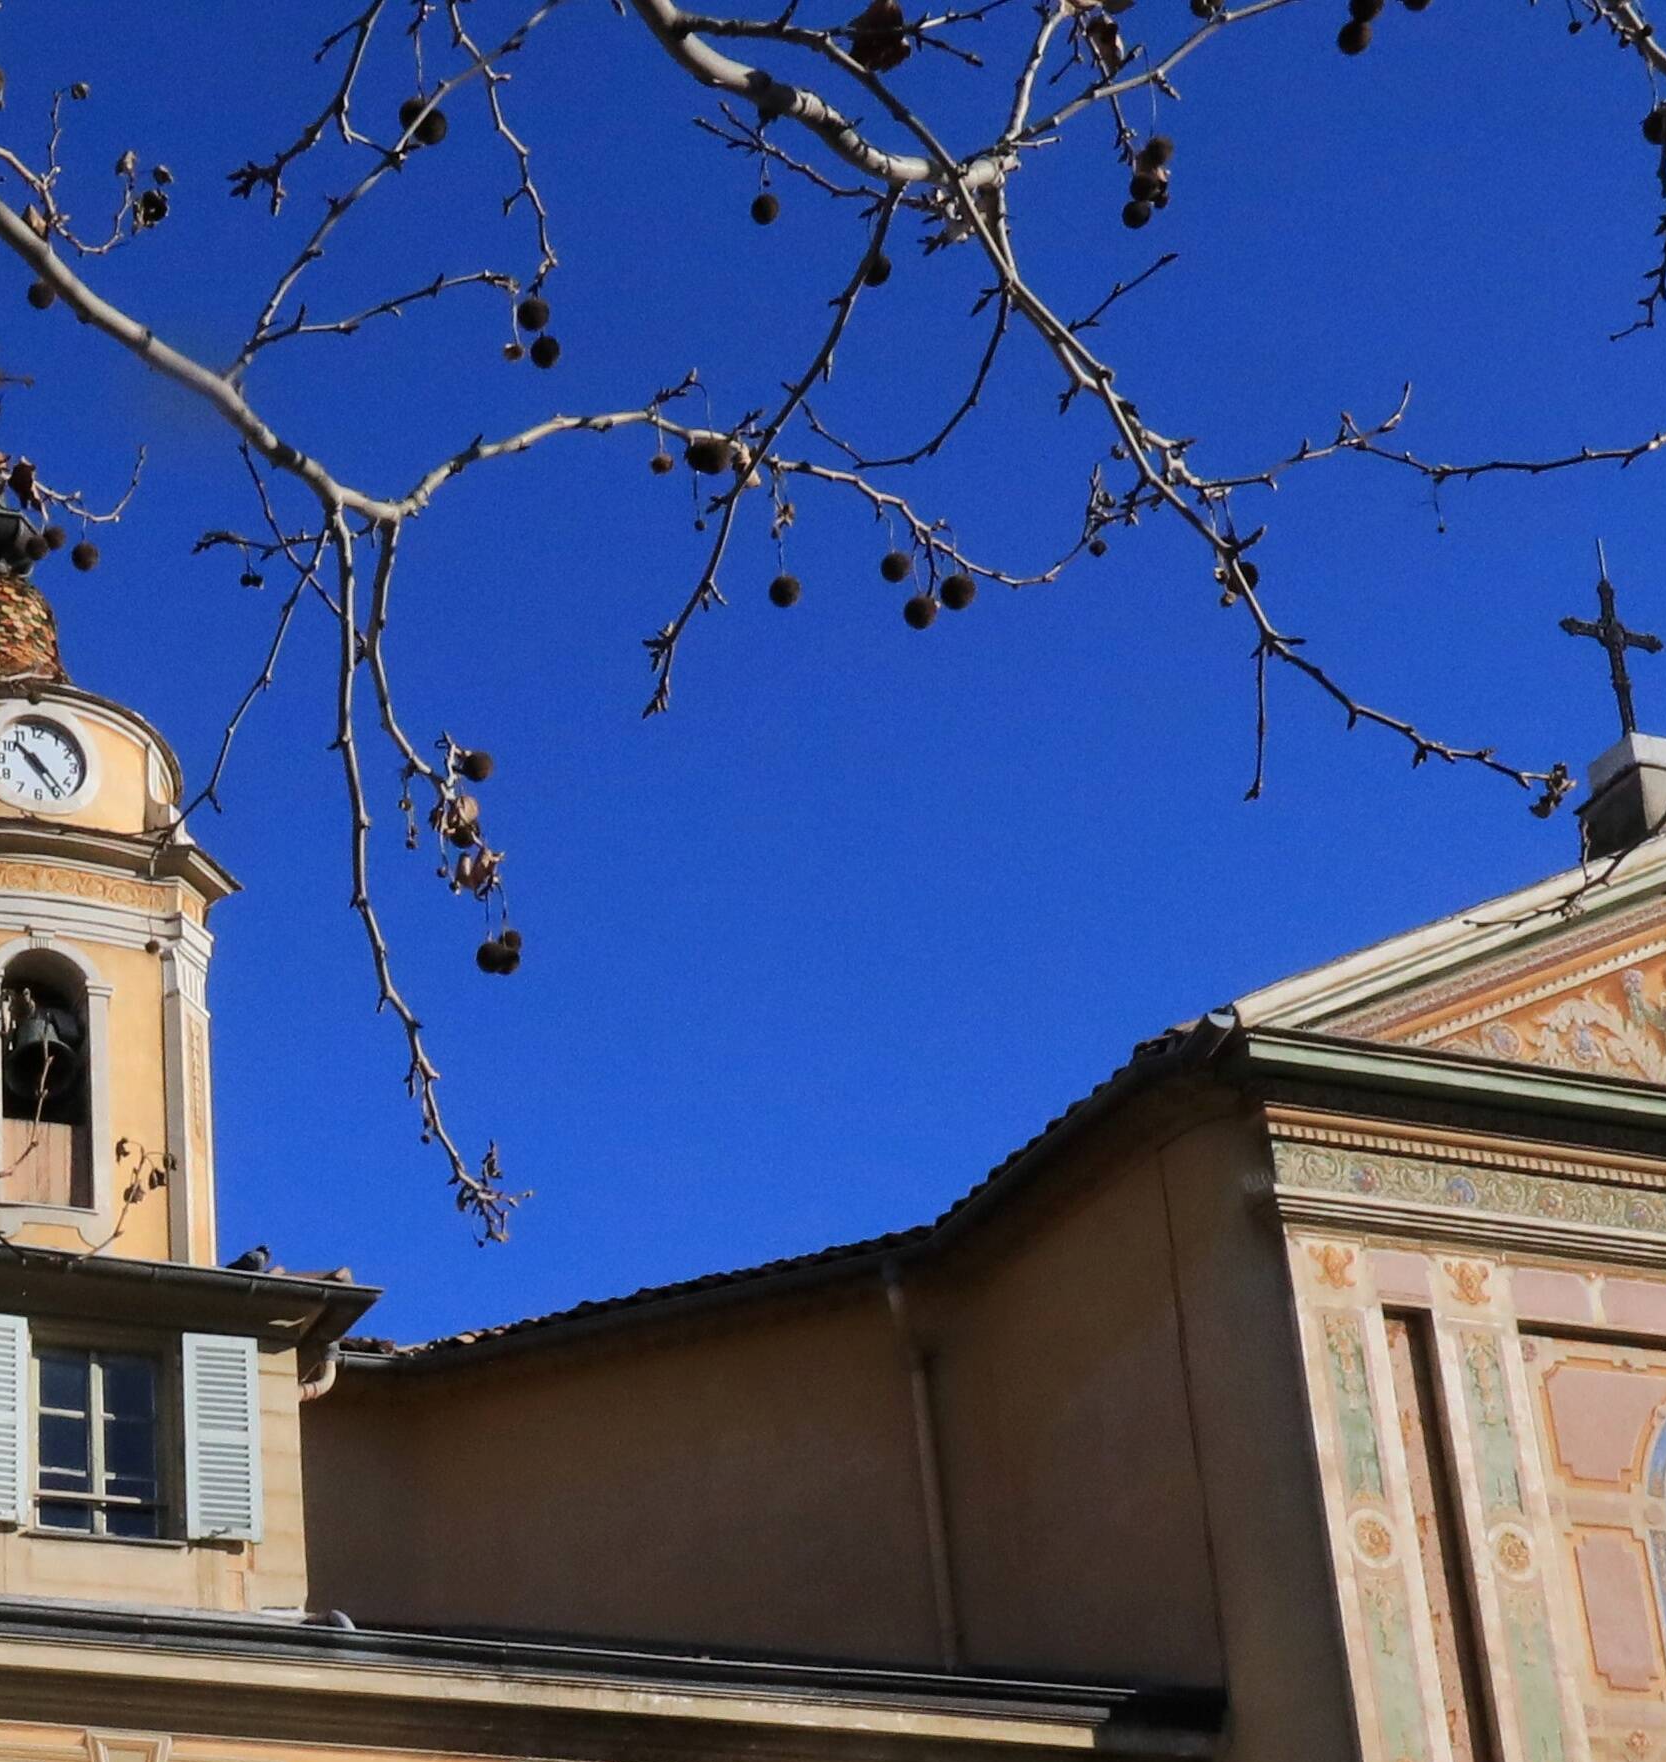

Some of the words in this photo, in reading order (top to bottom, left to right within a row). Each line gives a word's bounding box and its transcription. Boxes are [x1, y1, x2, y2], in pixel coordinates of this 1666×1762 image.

[14, 730, 25, 741] 11
[31, 726, 44, 739] 12
[2, 740, 15, 752] 10
[2, 768, 11, 780] 8
[69, 763, 78, 774] 3
[15, 781, 25, 793] 7
[34, 789, 43, 801] 6
